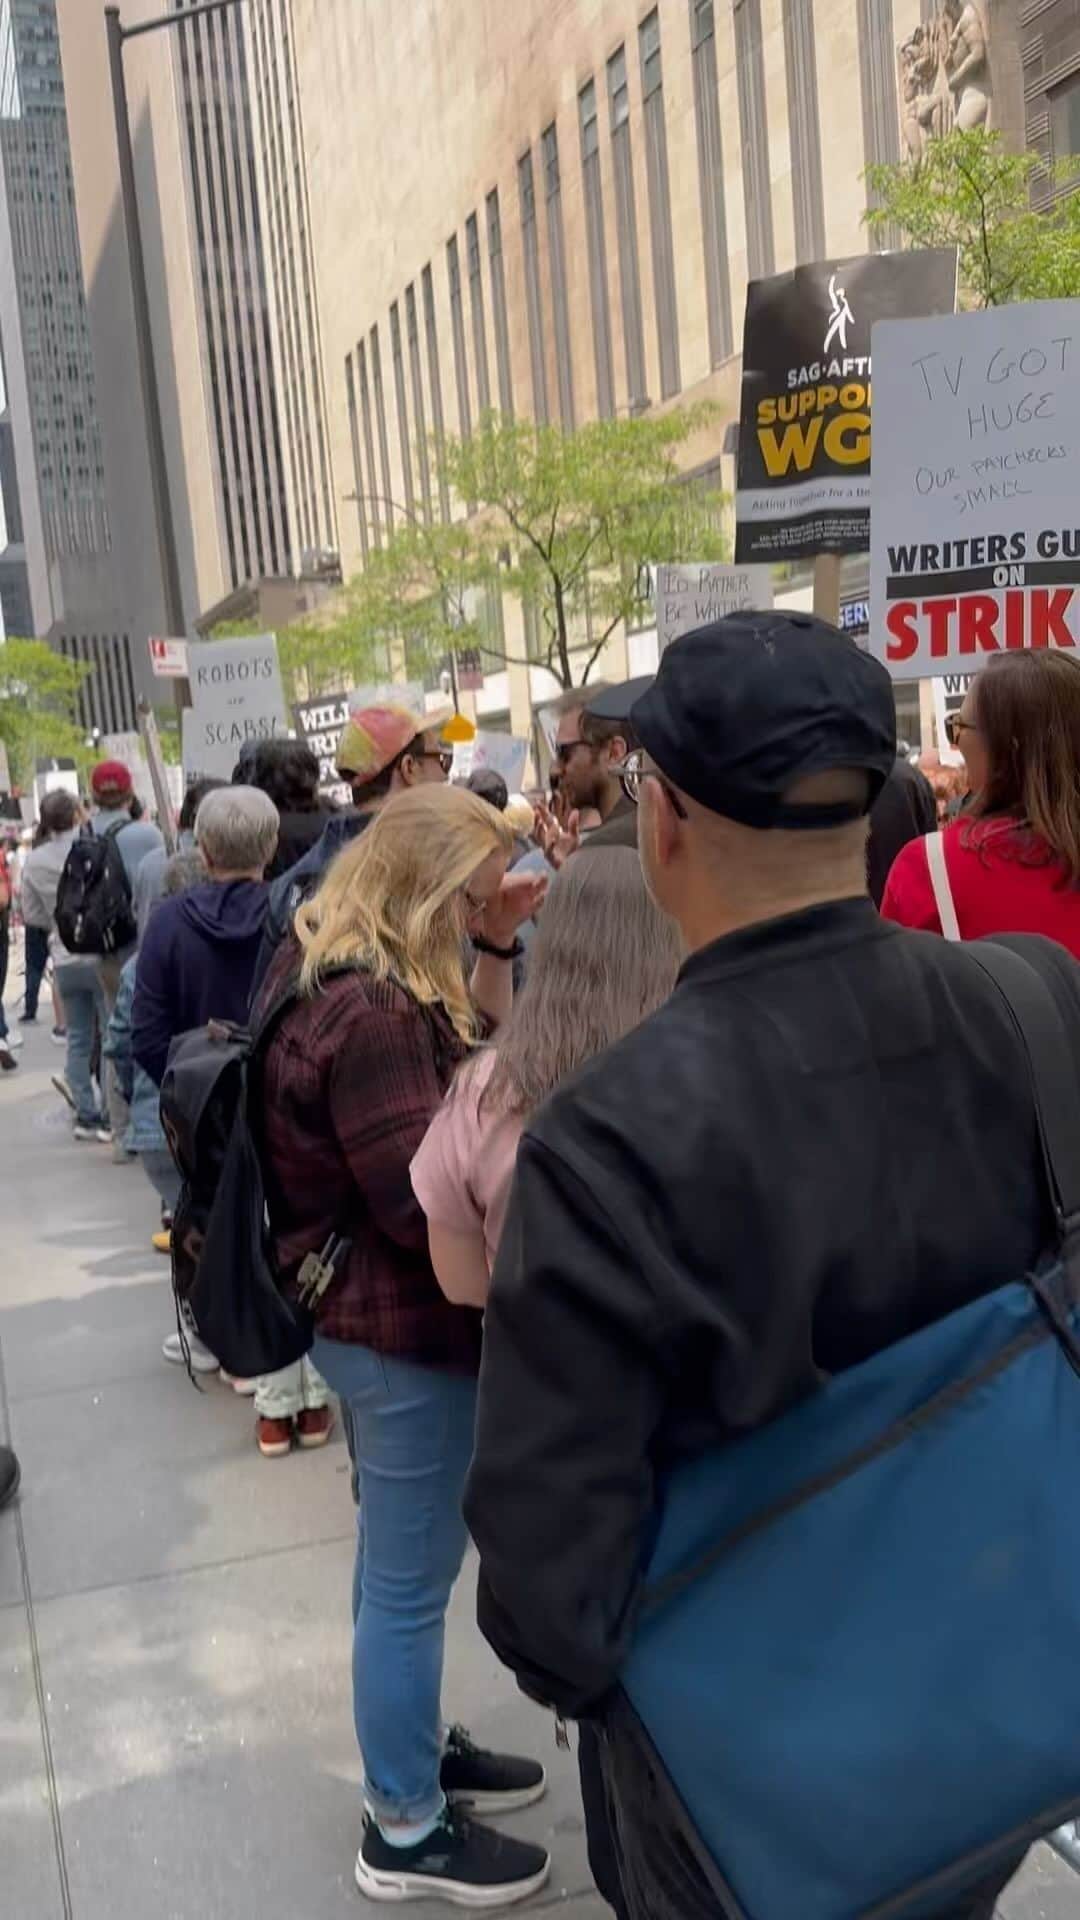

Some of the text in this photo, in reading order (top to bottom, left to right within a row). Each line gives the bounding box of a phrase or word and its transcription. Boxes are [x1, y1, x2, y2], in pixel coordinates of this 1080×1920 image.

[787, 356, 871, 388] SAG·AFT
[912, 337, 1072, 400] TV GOT
[757, 383, 871, 425] SUPPO
[967, 392, 1055, 440] HUGE
[916, 445, 1067, 494] OUR PAYCHECKS
[954, 480, 1032, 513] SMALL
[887, 532, 1027, 573] WRITERS
[1036, 529, 1080, 559] GU
[993, 565, 1025, 587] ON
[886, 587, 1076, 662] STRIK
[198, 656, 274, 686] ROBOTS
